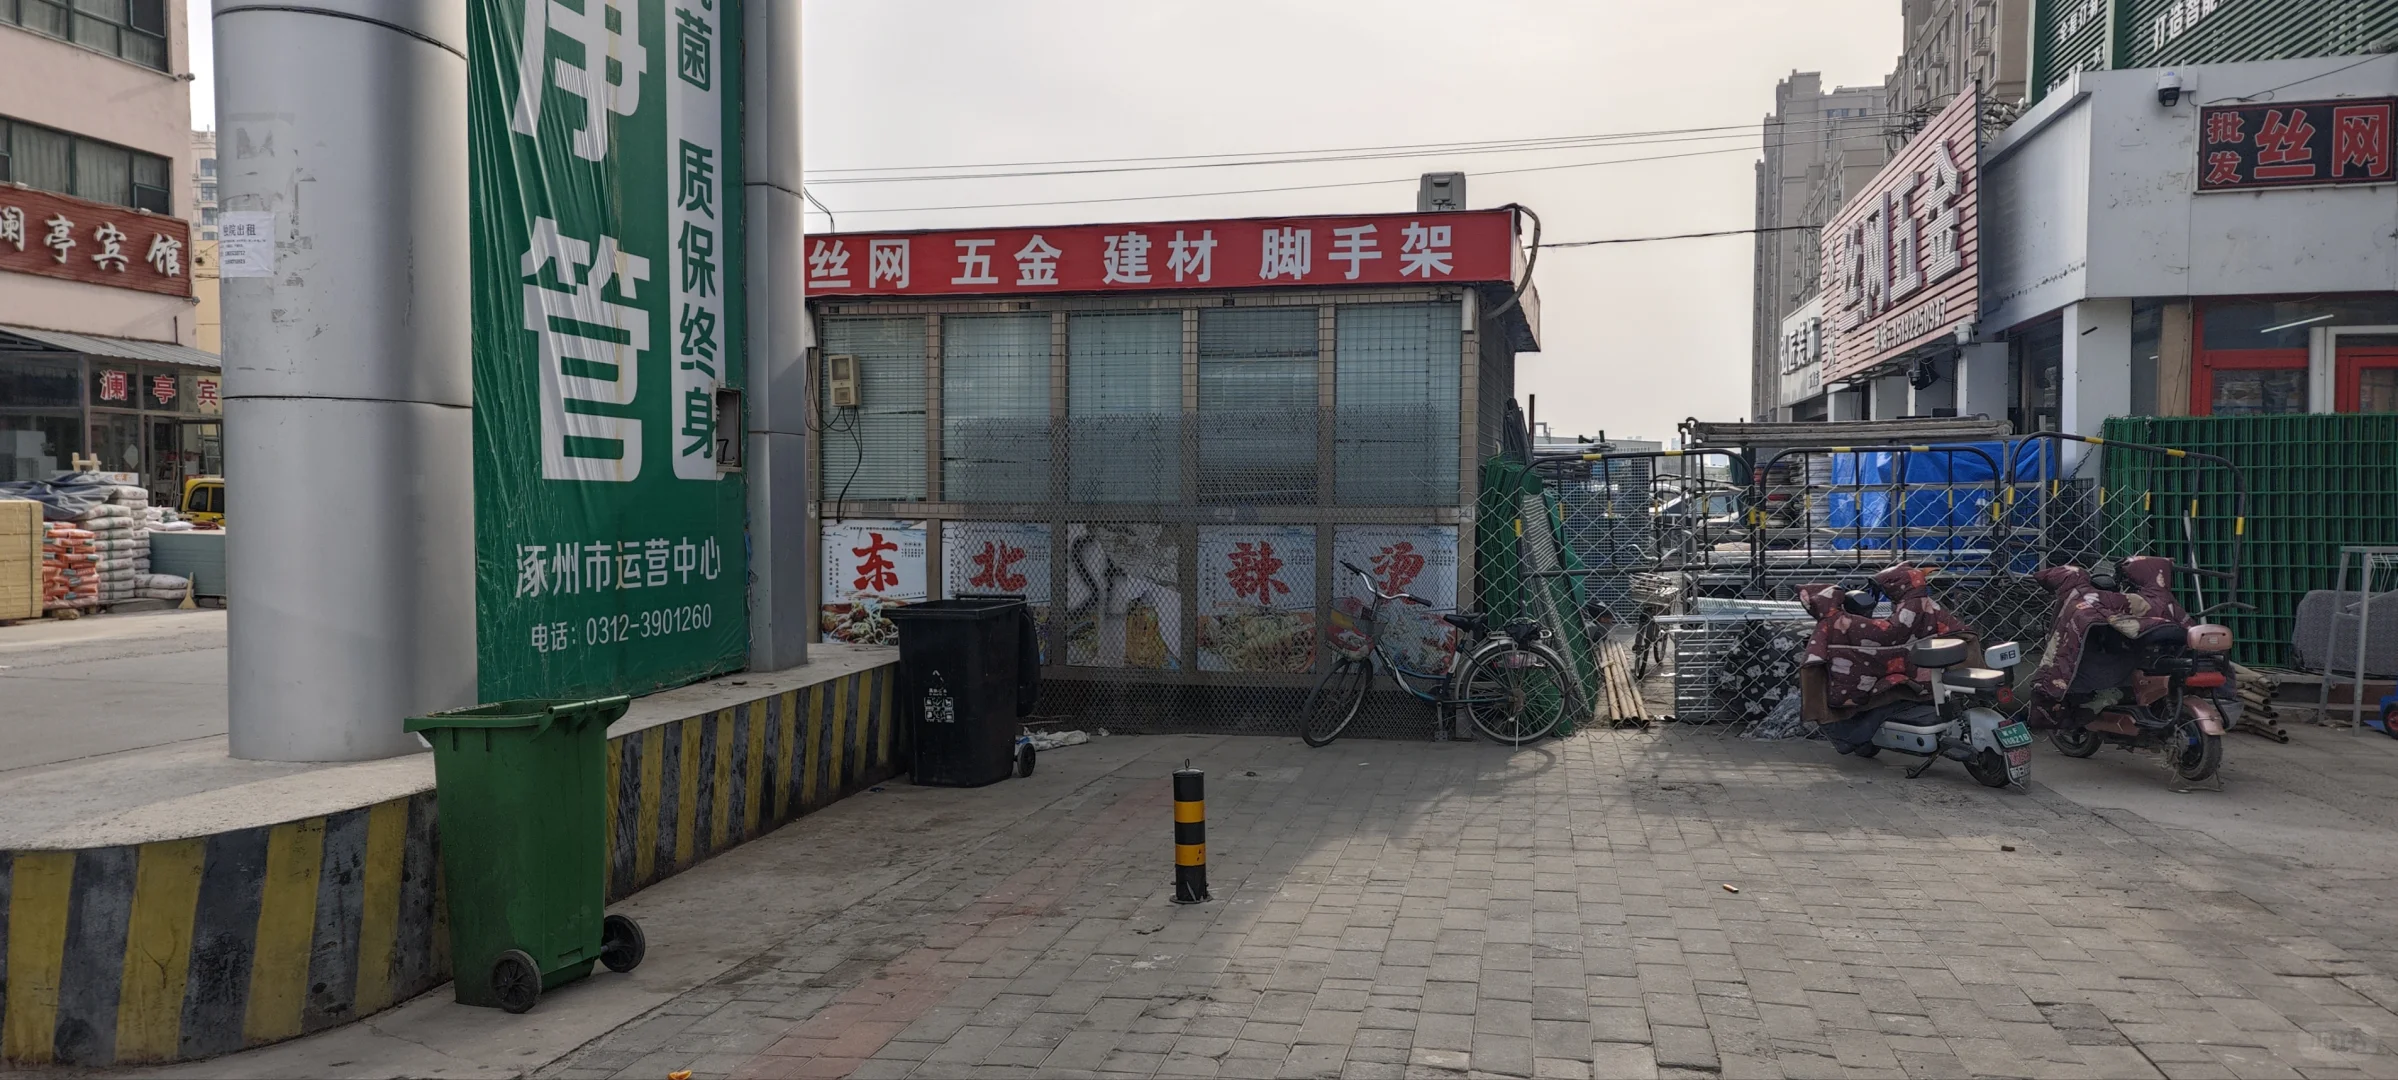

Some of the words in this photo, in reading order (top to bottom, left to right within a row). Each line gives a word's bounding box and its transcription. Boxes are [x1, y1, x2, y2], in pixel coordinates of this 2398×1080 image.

[675, 0, 713, 92] 菌
[2153, 0, 2223, 52] 打造智能
[2205, 111, 2245, 185] 批发
[2253, 104, 2391, 180] 丝网
[808, 239, 911, 289] 丝网
[950, 234, 1063, 286] 五金
[1101, 230, 1218, 285] 建材
[1258, 221, 1455, 281] 脚手架
[1838, 139, 1963, 333] 丝网五金
[677, 138, 718, 460] 质保终身
[514, 535, 722, 599] 涿州市运营中心
[851, 531, 900, 593] 东
[968, 539, 1028, 592] 北
[1224, 540, 1292, 606] 辣
